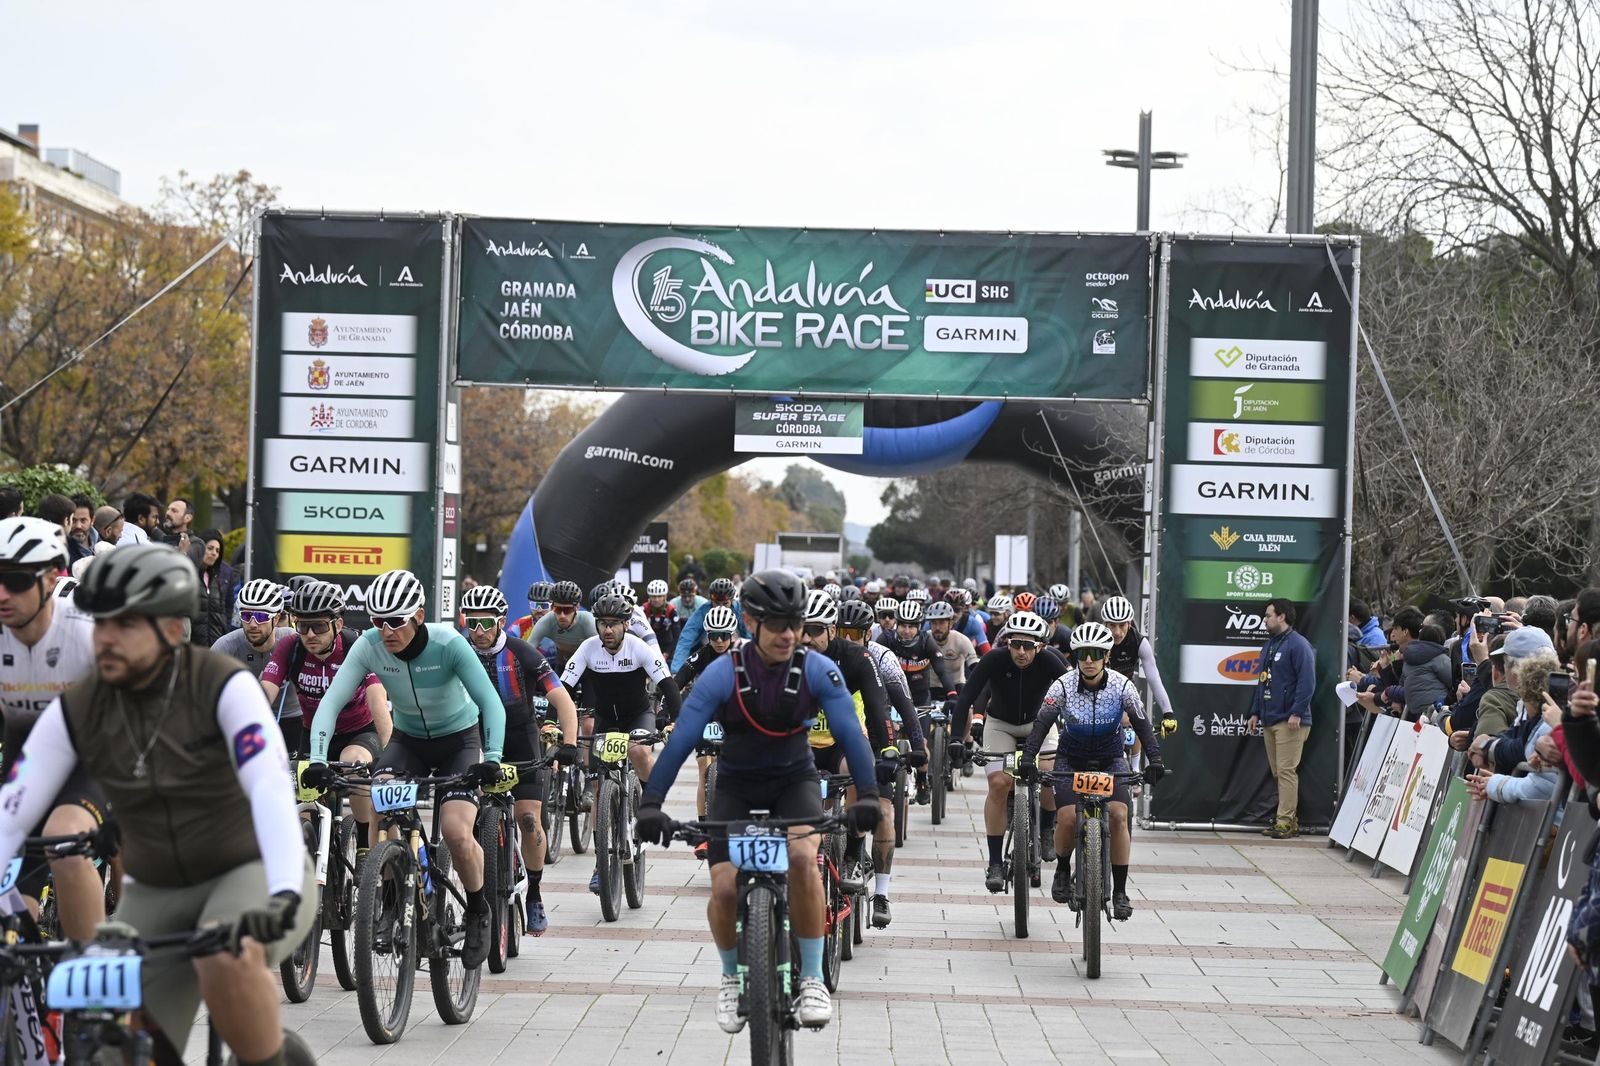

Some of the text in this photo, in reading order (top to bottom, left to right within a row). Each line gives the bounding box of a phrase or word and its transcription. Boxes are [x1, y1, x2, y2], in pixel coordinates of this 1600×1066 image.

[486, 239, 555, 260] Andalucía
[279, 262, 368, 288] Andalucía
[1085, 272, 1130, 287] octagon
[500, 280, 577, 299] GRANADA
[689, 257, 910, 314] Andalucía
[935, 283, 1009, 299] UCI SHC
[1188, 287, 1278, 312] Andalucía
[500, 298, 542, 319] JAÉN
[651, 304, 676, 313] YEARS
[500, 320, 574, 341] CÓRDOBA
[691, 310, 911, 351] BIKE RACE
[936, 328, 1017, 342] GARMIN
[1245, 353, 1298, 366] Diputación
[1245, 363, 1300, 372] de Granada
[334, 371, 390, 380] AYUNTAMIENTO
[334, 378, 365, 387] DE JAÉN
[336, 408, 388, 419] AYUNTAMIENTO
[752, 411, 846, 422] SUPER STAGE
[335, 419, 344, 429] DE
[775, 421, 822, 434] CÓRDOBA
[775, 440, 822, 449] GARMIN
[1245, 435, 1296, 447] Diputación
[584, 445, 674, 470] garmin.com
[1244, 446, 1296, 456] de Córdoba
[289, 455, 401, 475] GARMIN
[1197, 481, 1310, 501] GARMIN
[1266, 534, 1297, 544] RURAL
[303, 545, 383, 565] PIRELLI
[707, 724, 724, 736] 10
[1210, 726, 1235, 737] BIKE
[606, 740, 626, 755] 666
[1076, 773, 1111, 792] 512-2
[377, 786, 412, 807] 1092
[737, 840, 781, 866] 1137
[1463, 881, 1514, 958] PIRELLI
[66, 963, 126, 998] 1111
